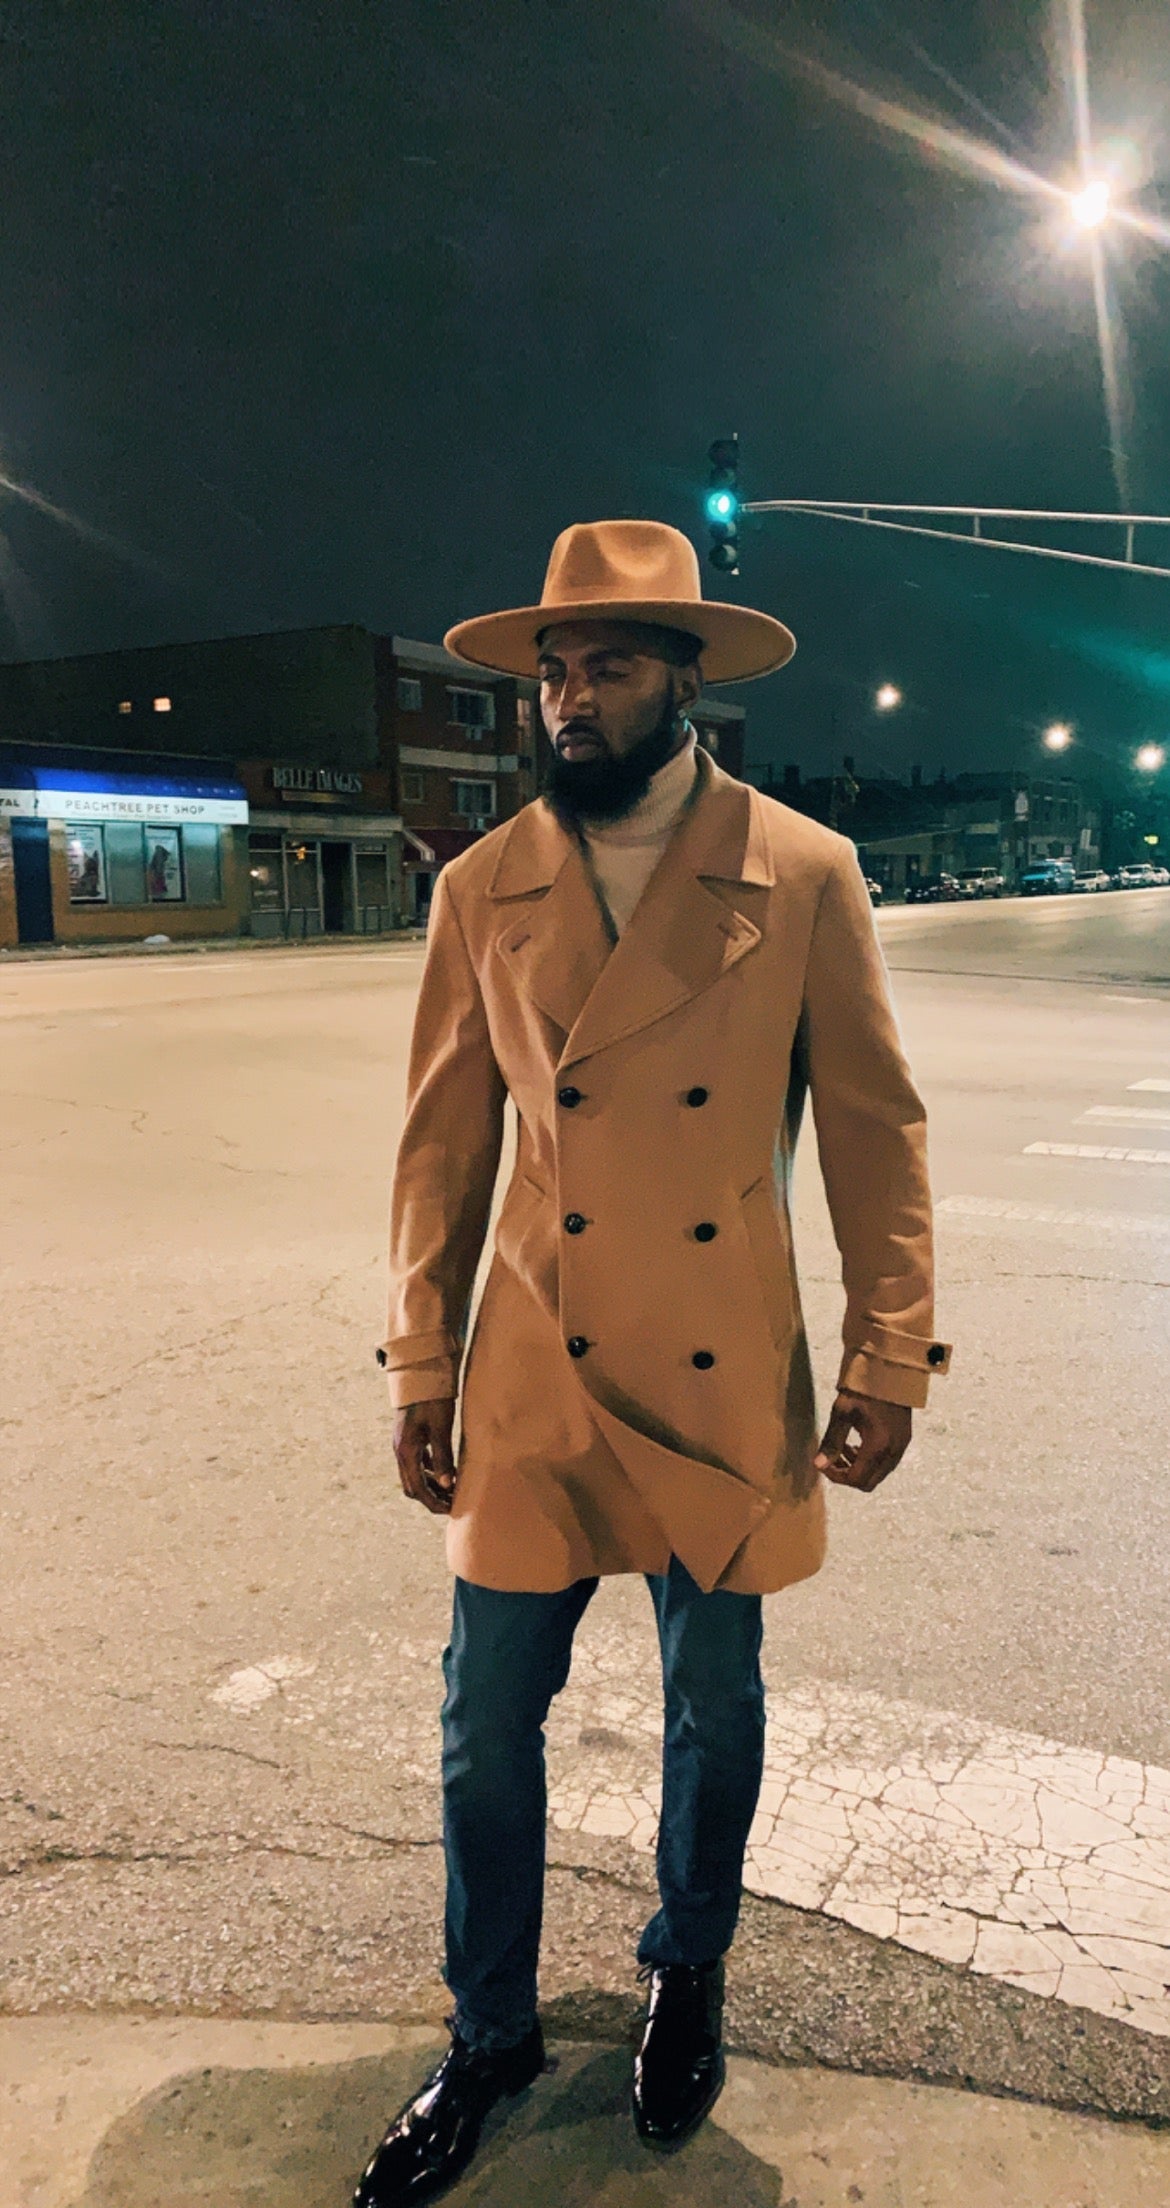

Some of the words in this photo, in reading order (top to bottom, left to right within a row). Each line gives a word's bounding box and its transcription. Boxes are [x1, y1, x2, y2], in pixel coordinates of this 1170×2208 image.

[273, 767, 314, 789] BELLE
[317, 769, 362, 792] IMAGES
[65, 800, 142, 813] PEACHTREE
[147, 803, 169, 814] PET
[174, 804, 205, 815] SHOP
